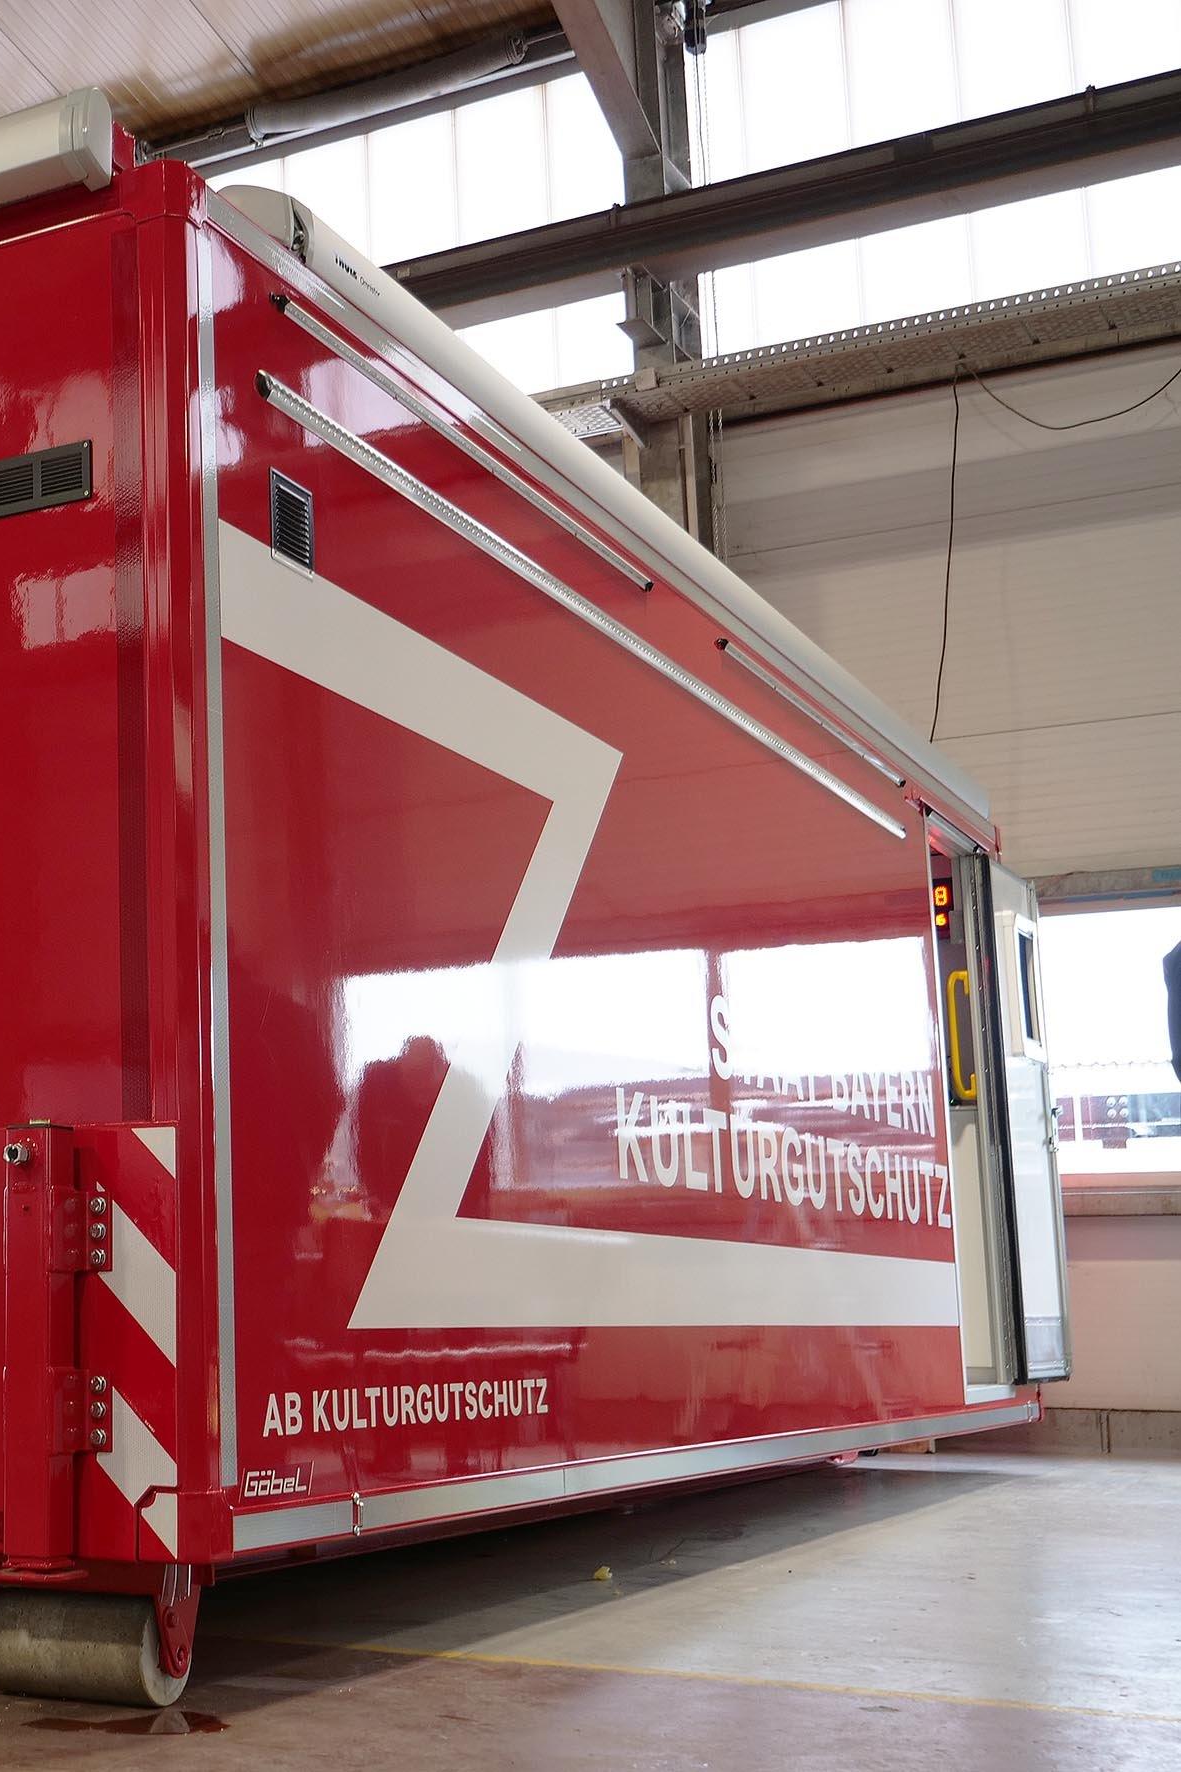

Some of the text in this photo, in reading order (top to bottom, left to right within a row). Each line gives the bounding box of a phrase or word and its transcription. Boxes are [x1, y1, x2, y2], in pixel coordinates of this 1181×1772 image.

[831, 1071, 936, 1138] BAYERN
[615, 1086, 952, 1229] KULTURGUTSCHUTZ
[263, 1377, 549, 1437] AB KULTURGUTSCHUTZ
